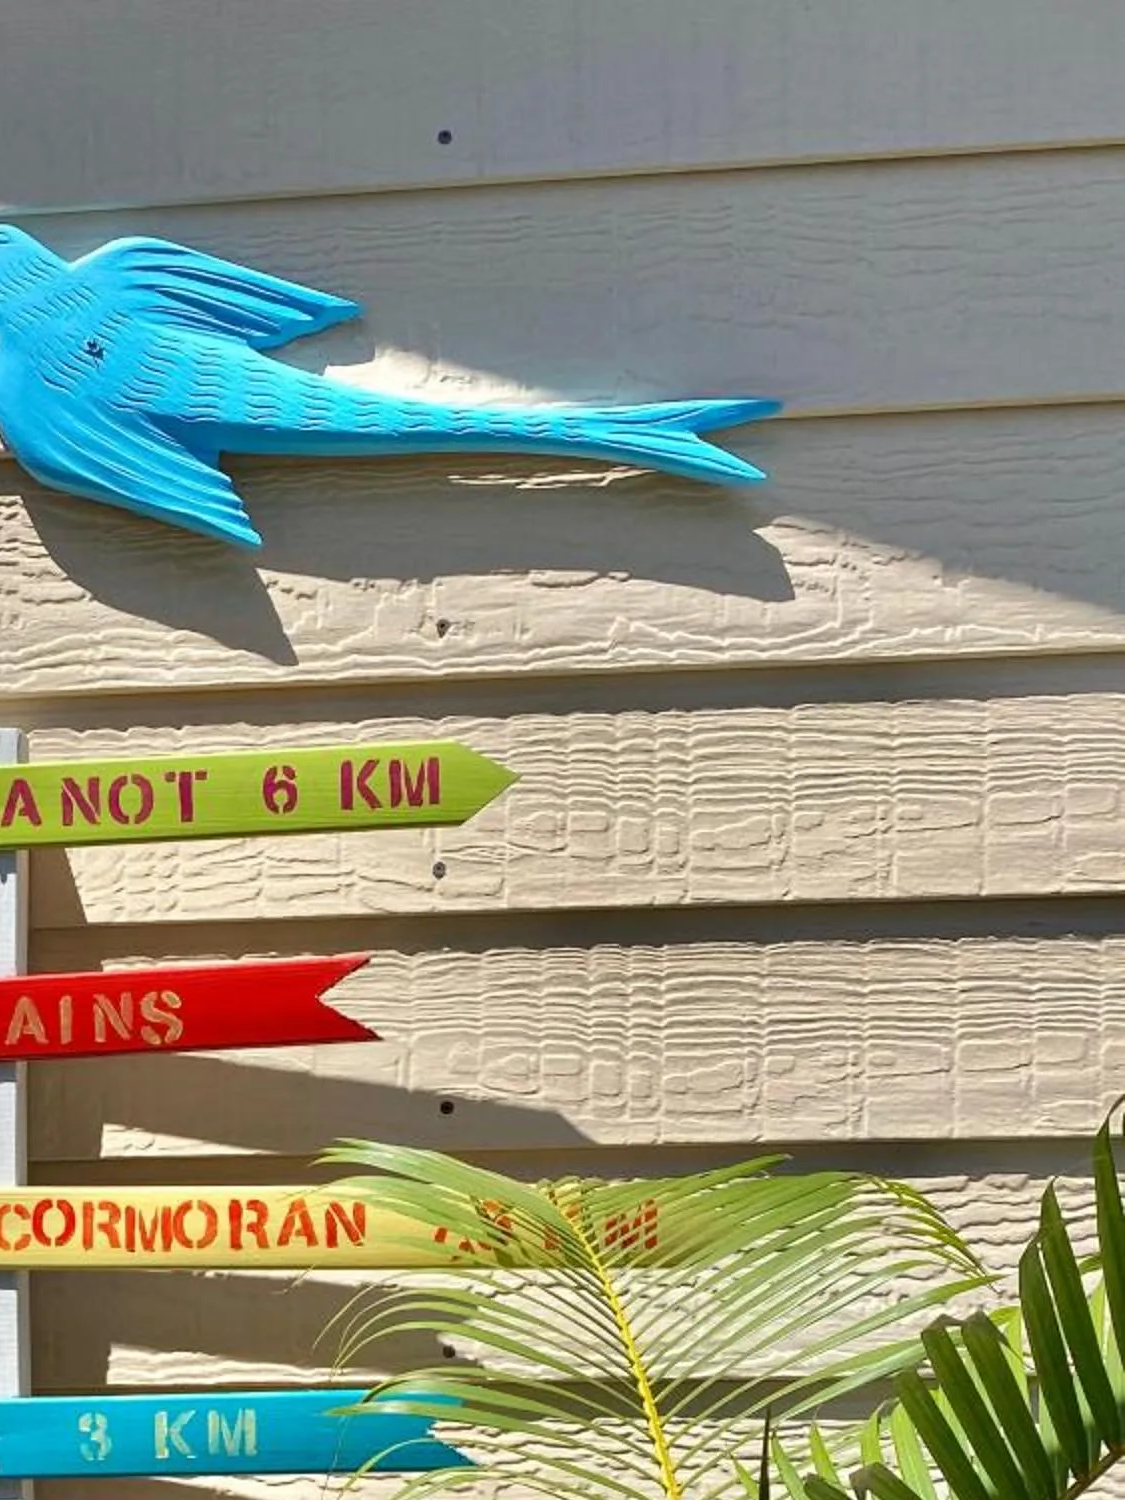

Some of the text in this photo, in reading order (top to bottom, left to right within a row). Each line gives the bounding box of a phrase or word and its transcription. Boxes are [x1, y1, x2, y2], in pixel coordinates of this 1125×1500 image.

[262, 765, 299, 815] 6
[340, 757, 441, 811] KM
[78, 1411, 112, 1461] 3
[154, 1407, 258, 1459] KM
